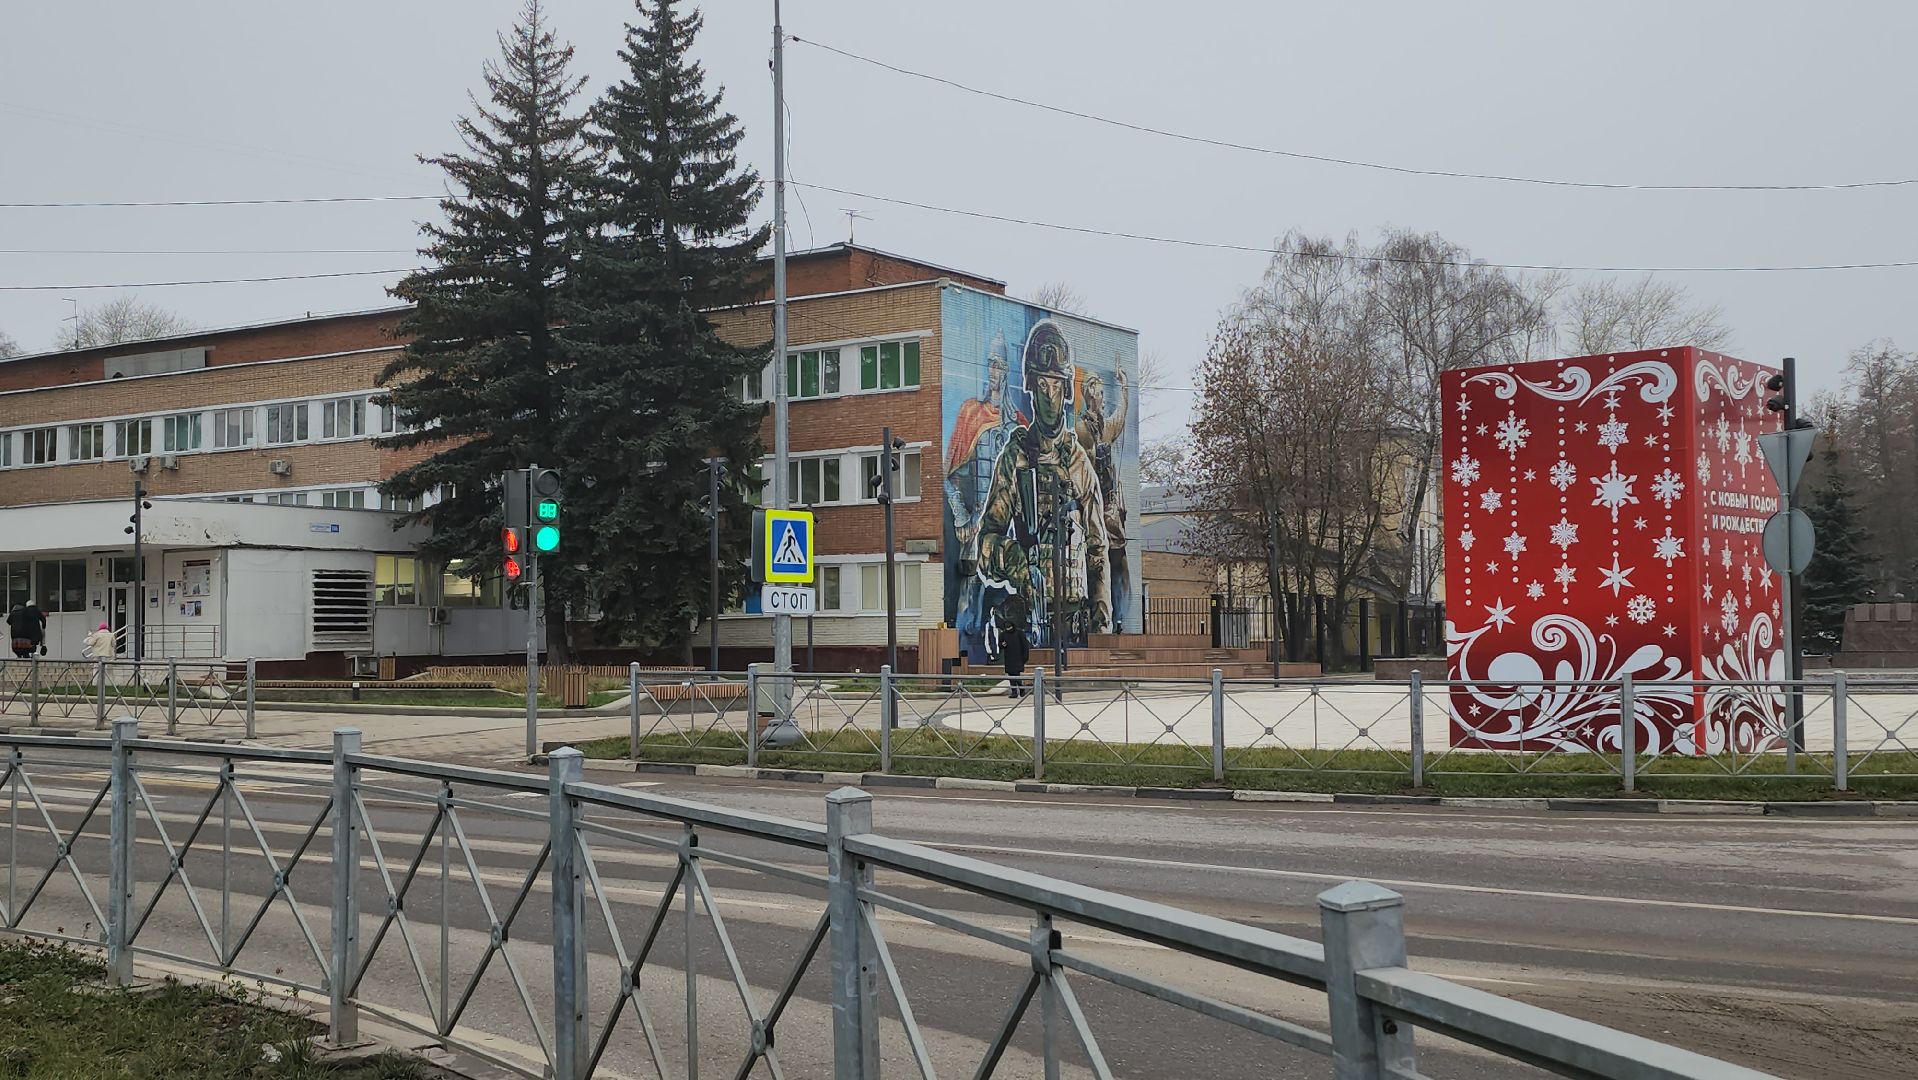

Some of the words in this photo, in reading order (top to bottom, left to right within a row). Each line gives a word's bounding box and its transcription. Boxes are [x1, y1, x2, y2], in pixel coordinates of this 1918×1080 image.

[1710, 490, 1716, 505] С
[1718, 492, 1749, 509] НОВЫМ
[1751, 495, 1777, 512] ГОДОМ
[1712, 514, 1718, 530] И
[771, 591, 808, 610] СТОП
